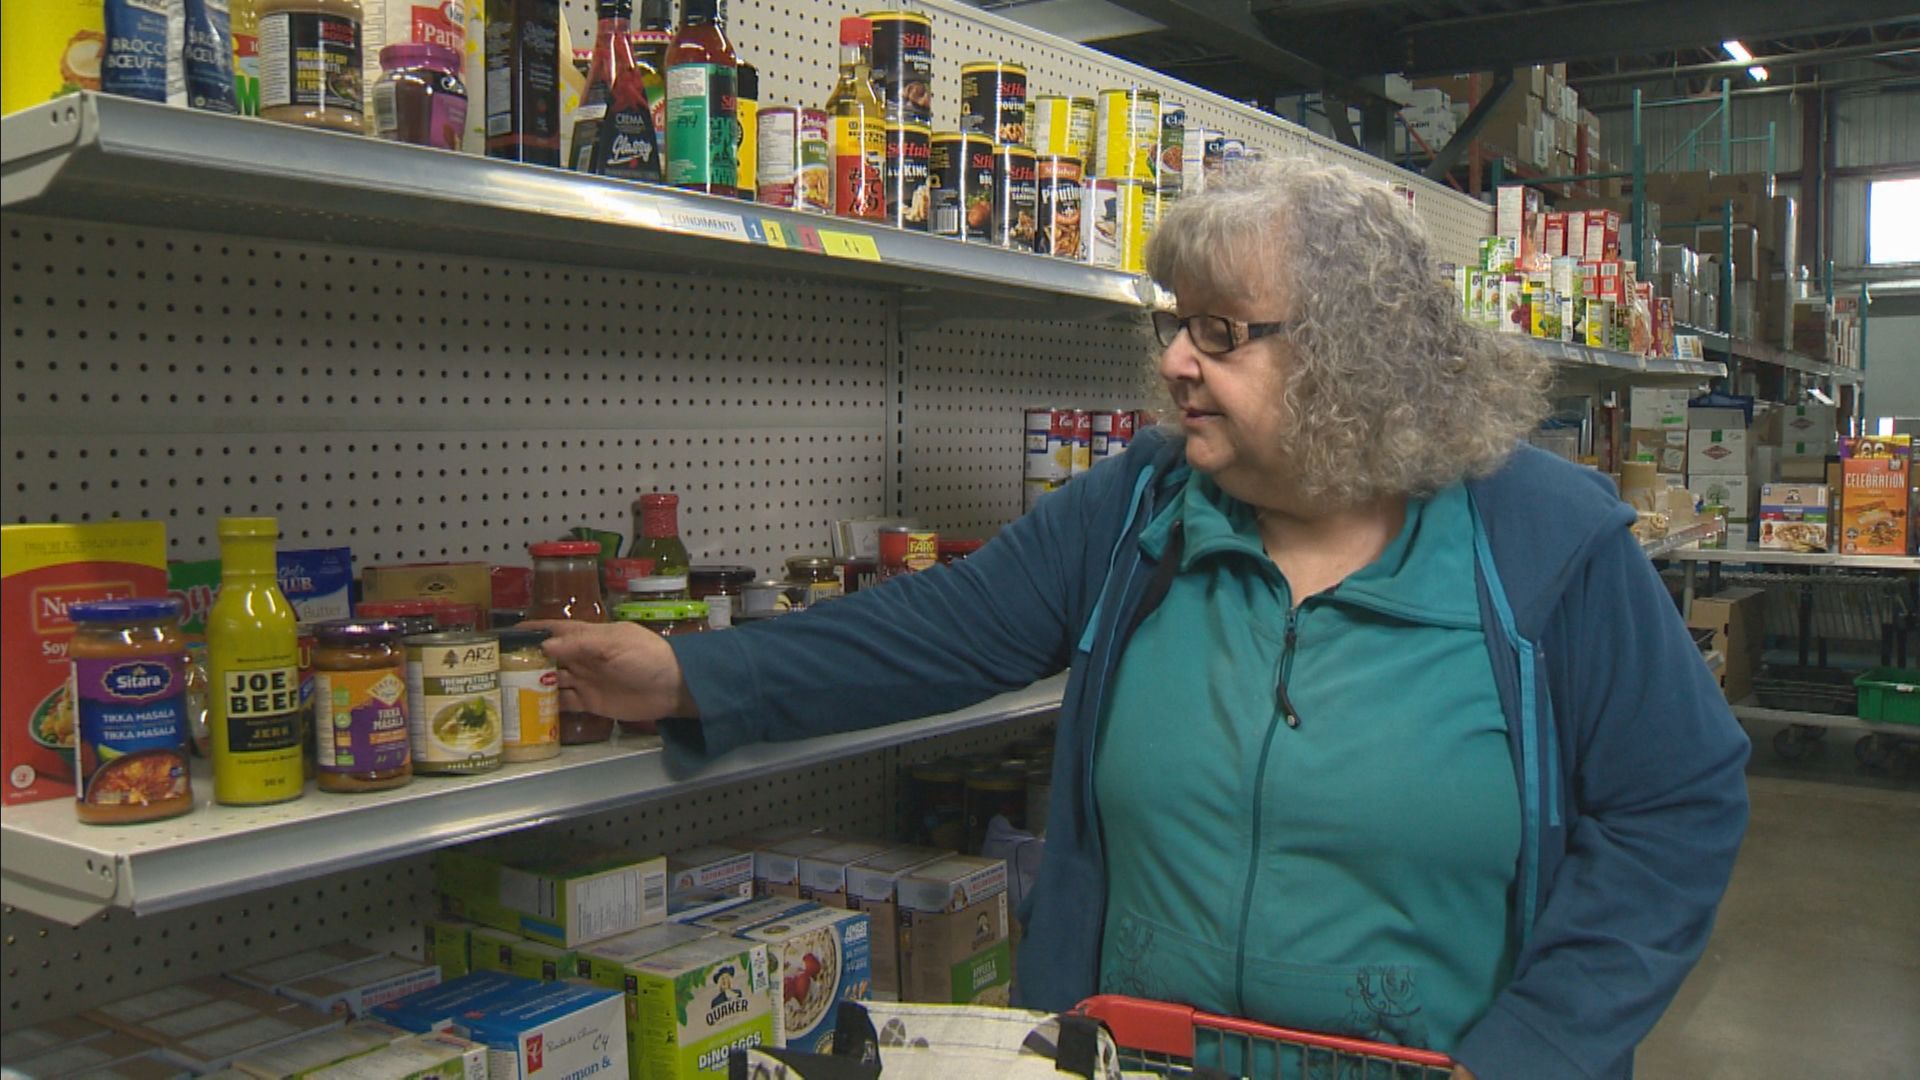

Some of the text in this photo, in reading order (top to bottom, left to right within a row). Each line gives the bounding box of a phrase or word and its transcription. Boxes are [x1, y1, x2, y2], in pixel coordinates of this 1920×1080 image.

[903, 164, 928, 178] KING
[671, 212, 738, 233] CONDIMENTS
[749, 222, 761, 239] 1
[769, 226, 778, 241] 1
[303, 604, 341, 619] Butter
[41, 640, 68, 656] Soy
[462, 646, 496, 663] ARZ
[115, 674, 161, 689] Sitara
[230, 671, 286, 692] JOE
[230, 689, 298, 714] BEEF
[102, 709, 176, 723] TIKKA MASALA
[103, 726, 177, 740] TIKKA MASALA
[705, 999, 749, 1026] QUAKER
